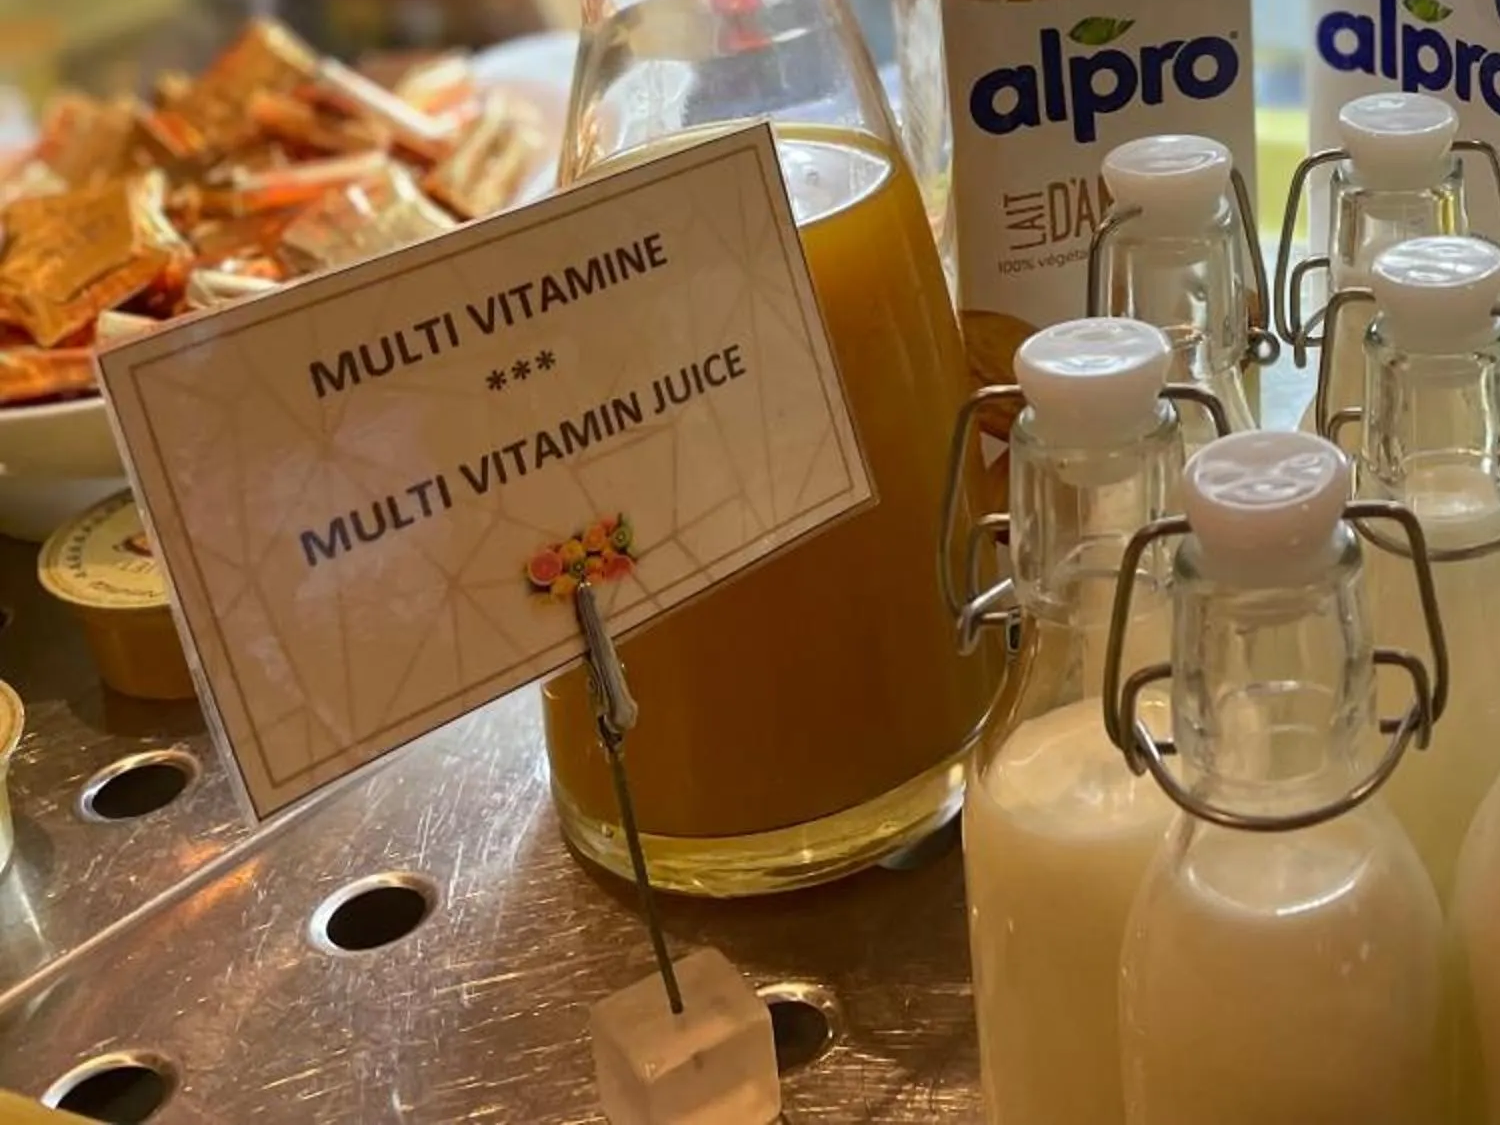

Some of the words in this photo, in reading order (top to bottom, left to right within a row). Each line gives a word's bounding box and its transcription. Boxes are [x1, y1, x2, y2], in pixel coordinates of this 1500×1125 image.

[969, 28, 1239, 143] alpro
[1003, 191, 1046, 251] LAIT
[309, 312, 460, 399] MULTI
[466, 232, 668, 335] VITAMINE
[299, 475, 452, 567] MULTI
[459, 391, 643, 495] VITAMIN
[653, 345, 746, 415] JUICE
